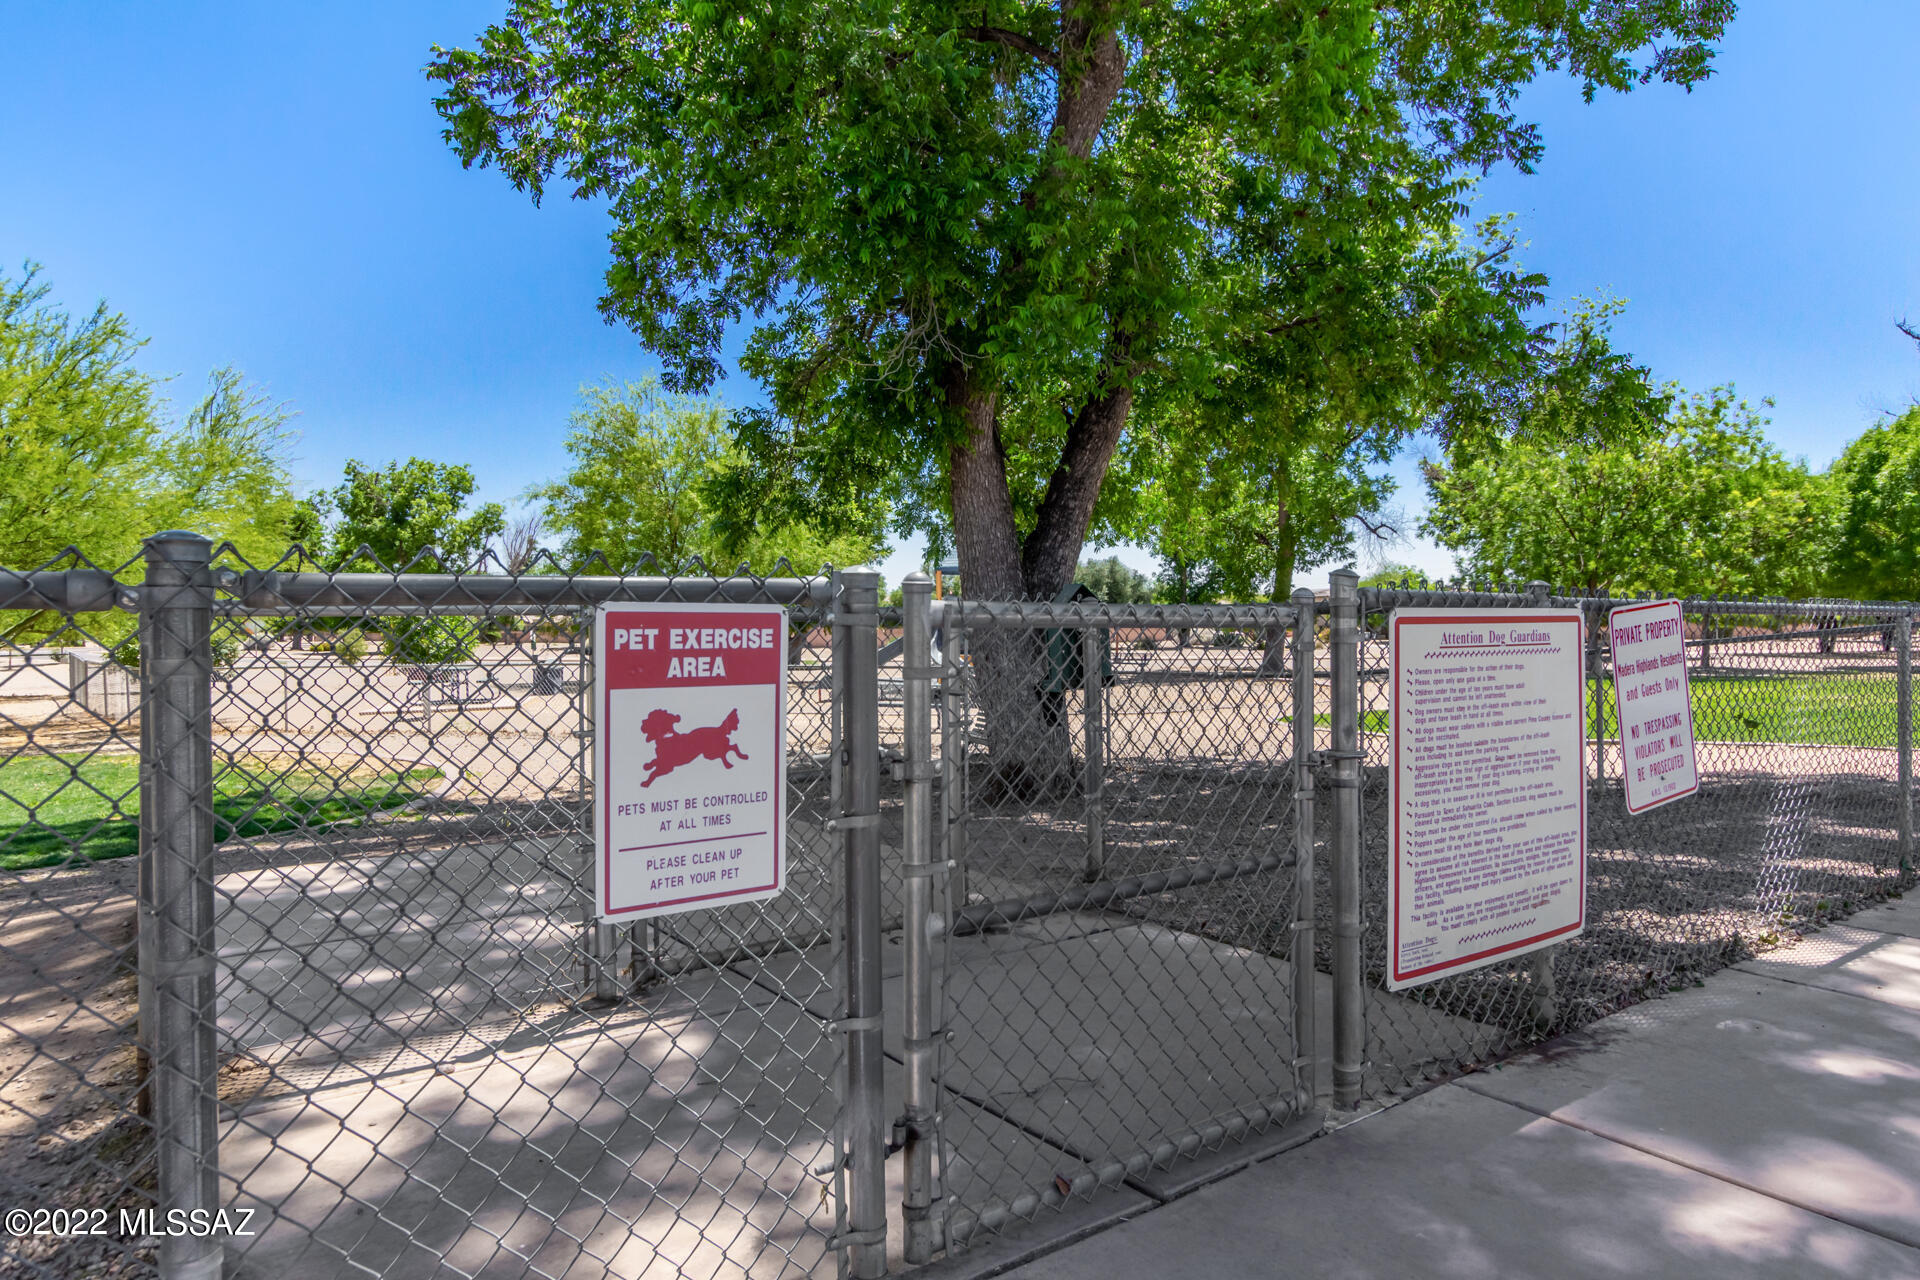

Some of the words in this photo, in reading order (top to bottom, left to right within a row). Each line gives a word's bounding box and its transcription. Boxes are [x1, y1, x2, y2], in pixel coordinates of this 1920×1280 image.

[614, 628, 659, 650] PET
[669, 628, 774, 650] EXERCISE
[1440, 630, 1484, 645] Attention
[1489, 630, 1506, 645] Dog
[1510, 628, 1551, 644] Guardians
[1615, 624, 1643, 647] PRIVATE
[1646, 618, 1679, 641] PROPERTY
[667, 656, 726, 678] AREA
[1617, 661, 1635, 678] Madera
[1636, 656, 1659, 676] Highlands
[1659, 651, 1683, 668] Residents
[1626, 686, 1638, 701] and
[1641, 681, 1662, 697] Guests
[1665, 677, 1679, 692] Only
[1631, 725, 1640, 740] NO
[1644, 712, 1682, 736] TRESPASSING
[1634, 738, 1665, 761] VIOLATORS
[1669, 733, 1683, 749] WILL
[1637, 767, 1646, 782] BE
[1649, 754, 1685, 777] PROSECUTED
[618, 803, 645, 816] PETS
[651, 801, 679, 813] MUST
[684, 798, 698, 809] BE
[703, 791, 768, 808] CONTROLLED
[660, 819, 671, 832] AT
[678, 817, 697, 829] ALL
[703, 814, 731, 828] TIMES
[646, 856, 687, 871] PLEASE
[692, 851, 726, 866] CLEAN
[730, 848, 742, 860] UP
[650, 876, 684, 890] AFTER
[690, 871, 716, 884] YOUR
[721, 867, 739, 880] PET
